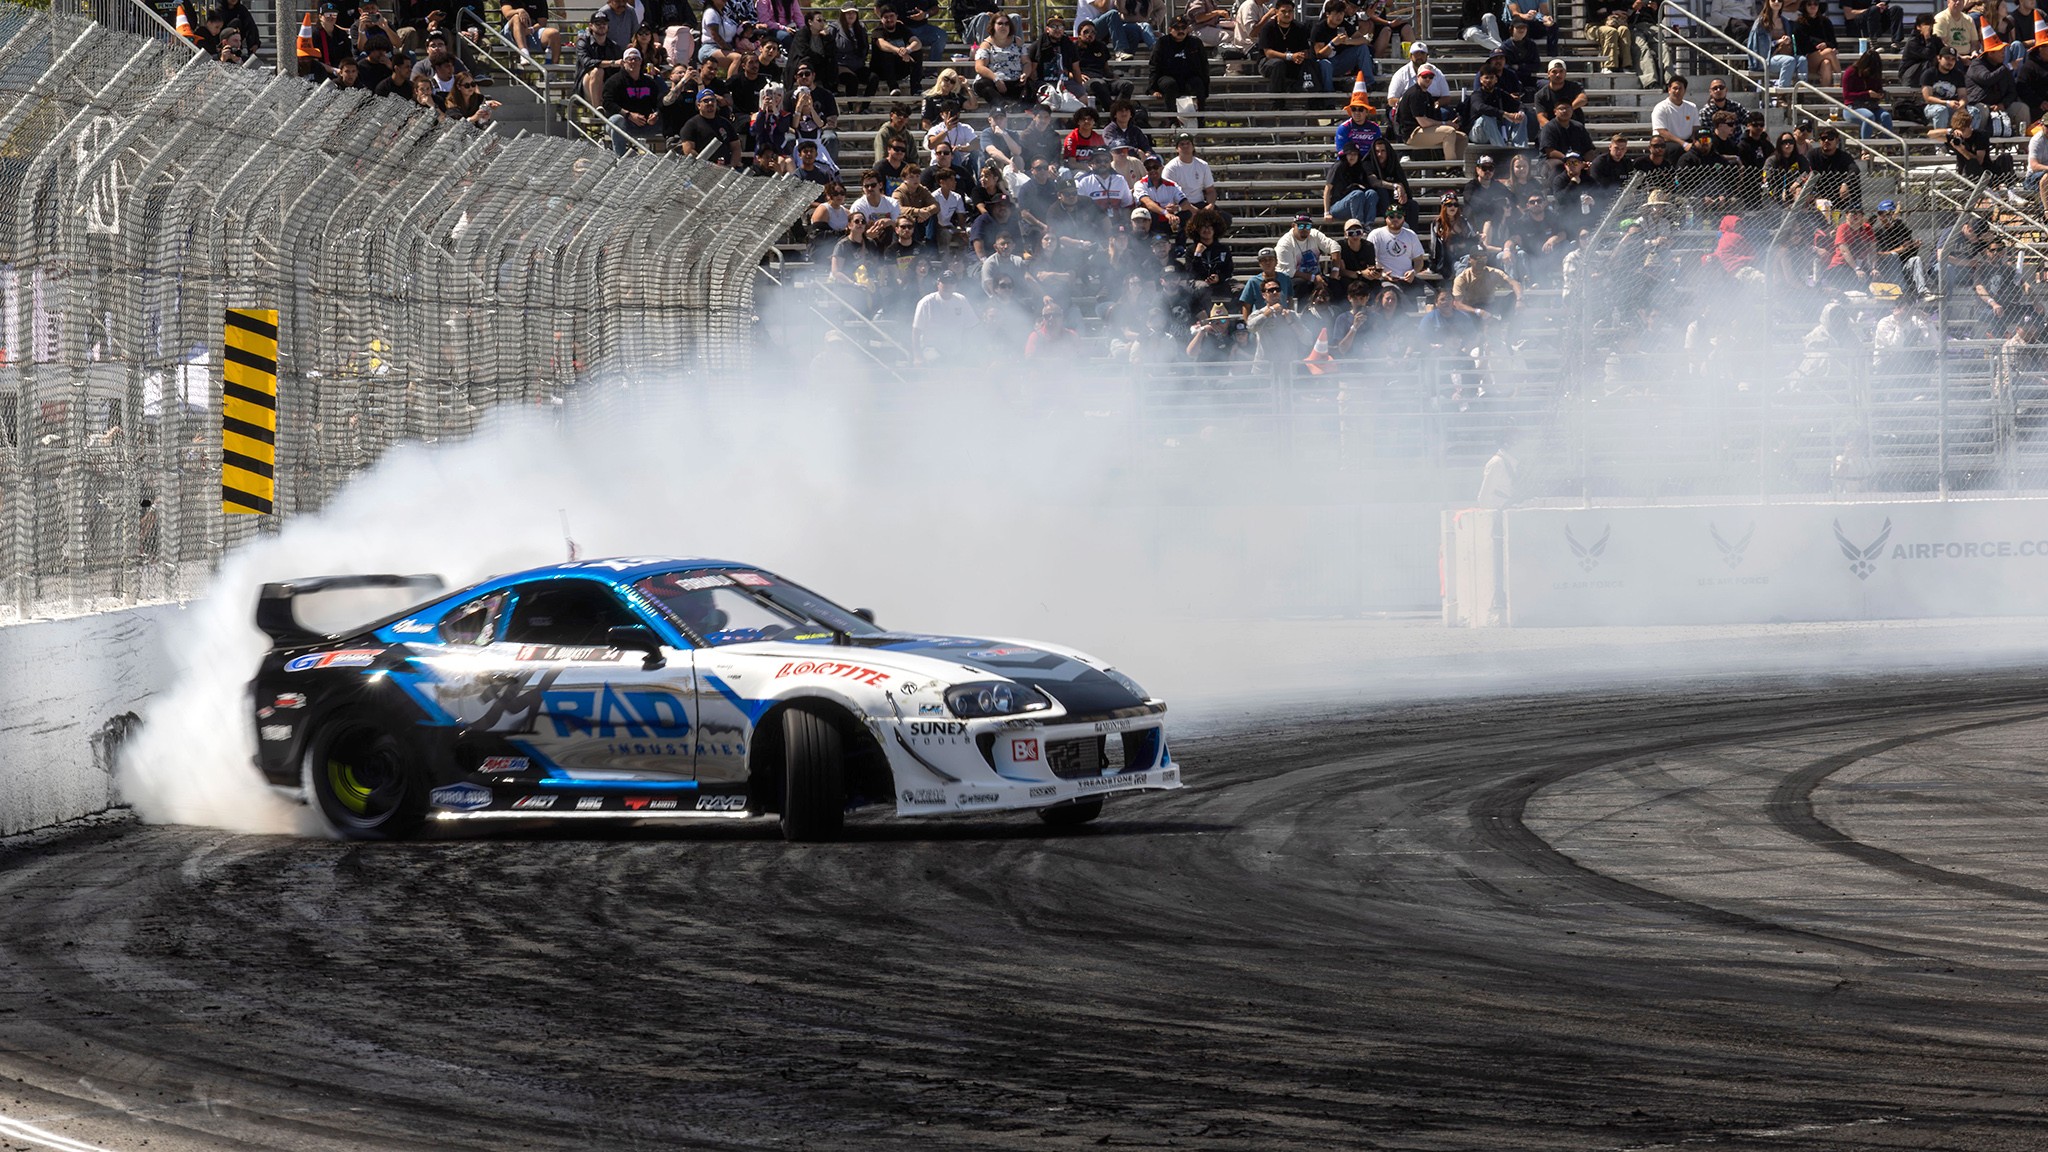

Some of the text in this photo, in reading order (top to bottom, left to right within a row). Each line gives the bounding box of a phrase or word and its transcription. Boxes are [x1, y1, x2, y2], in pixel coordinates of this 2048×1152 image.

[775, 661, 891, 687] LOCTITE
[541, 681, 692, 737] RAD
[910, 722, 968, 736] SUNEX
[910, 737, 971, 746] TOOLS
[608, 743, 746, 756] INDUSTRIES
[432, 790, 490, 804] PUROLATOR
